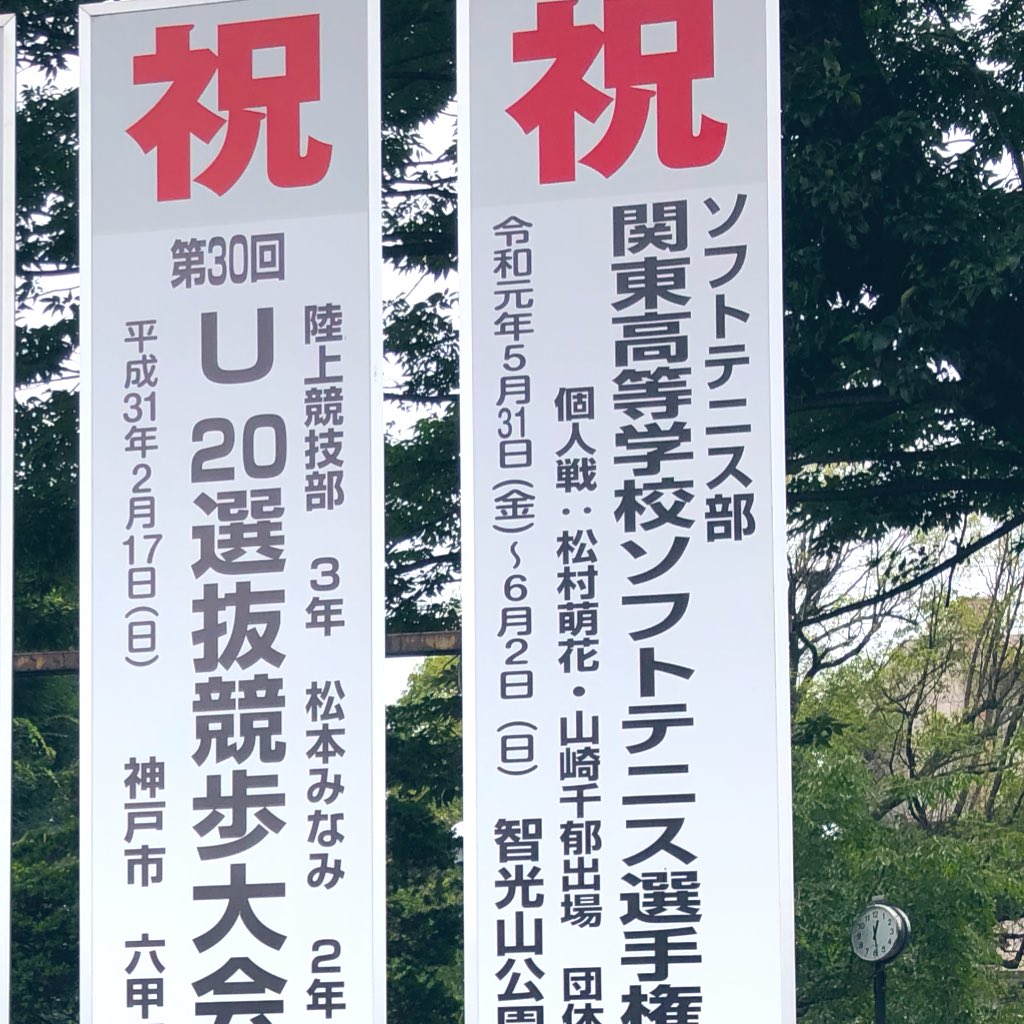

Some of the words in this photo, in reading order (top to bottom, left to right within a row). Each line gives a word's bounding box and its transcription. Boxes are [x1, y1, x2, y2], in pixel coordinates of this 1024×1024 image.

[126, 14, 332, 201] 祝
[505, 0, 727, 184] 祝
[171, 233, 284, 288] 第30回
[304, 303, 344, 511] 陸上競技部
[704, 194, 755, 542] ソフトテニス部
[306, 557, 344, 636] 3年
[124, 756, 165, 886] 神戸市
[306, 680, 345, 889] 松本みなみ
[307, 939, 346, 1019] 2年
